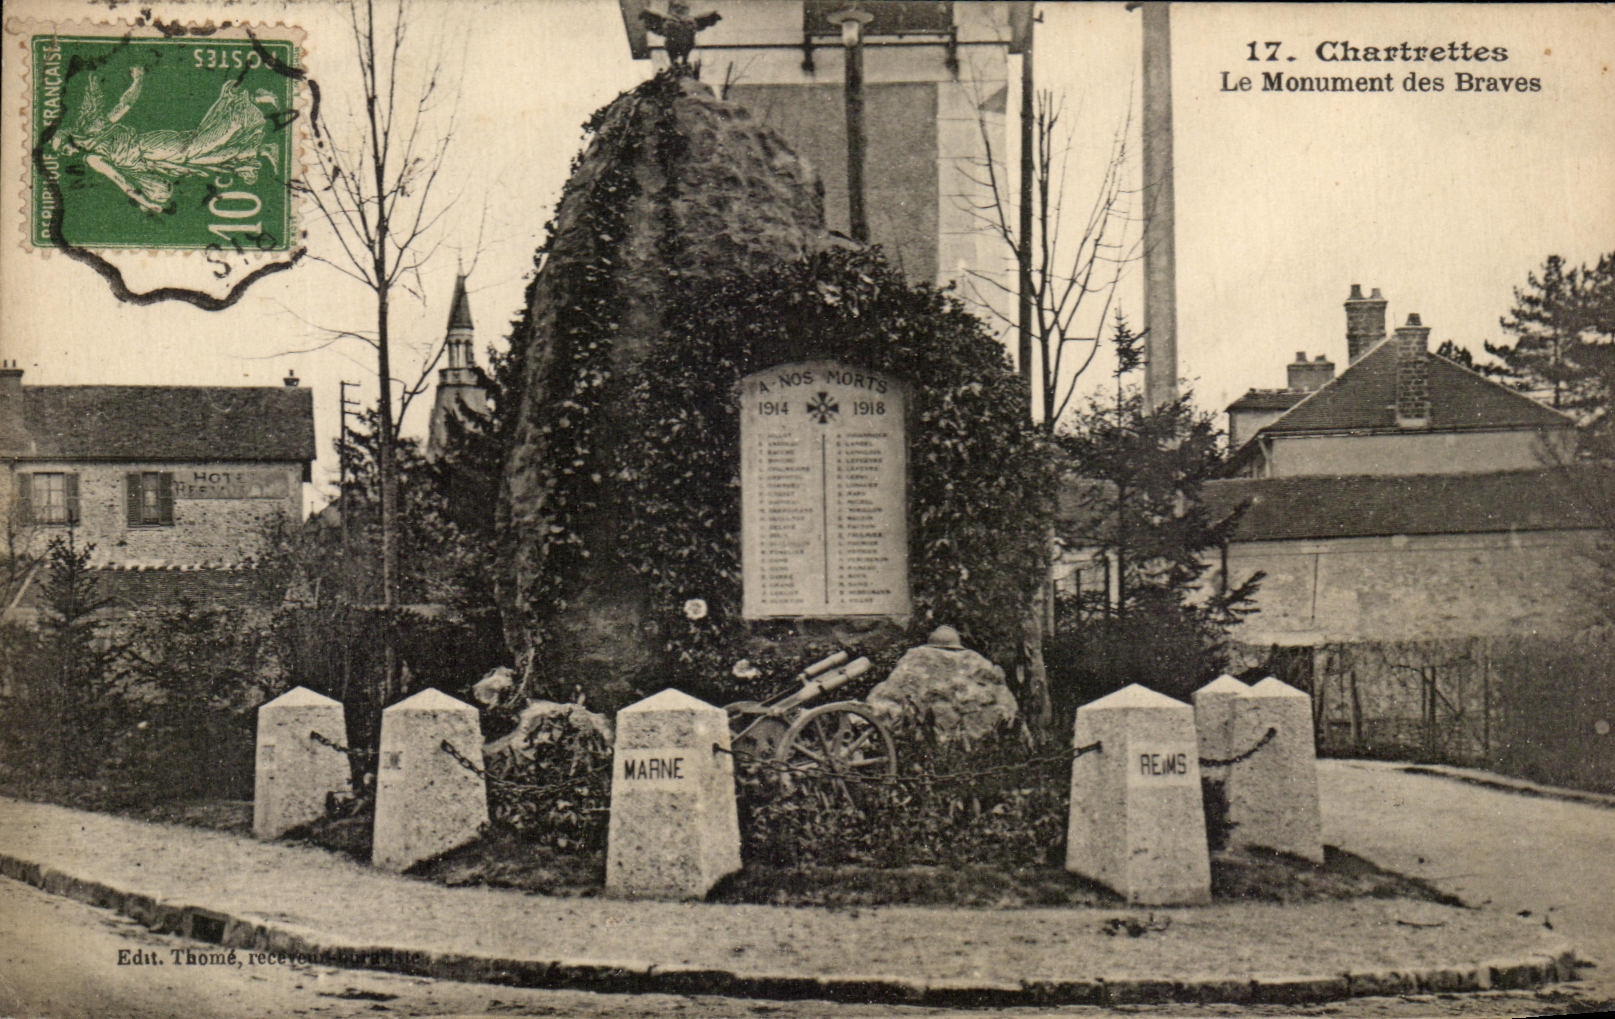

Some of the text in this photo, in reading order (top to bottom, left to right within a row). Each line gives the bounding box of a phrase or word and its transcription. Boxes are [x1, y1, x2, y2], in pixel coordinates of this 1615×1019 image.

[778, 371, 814, 388] NOS
[826, 371, 888, 394] MORTS
[759, 401, 886, 416] 1914 1918
[624, 757, 684, 780] MARNE
[1140, 753, 1187, 776] REIMS
